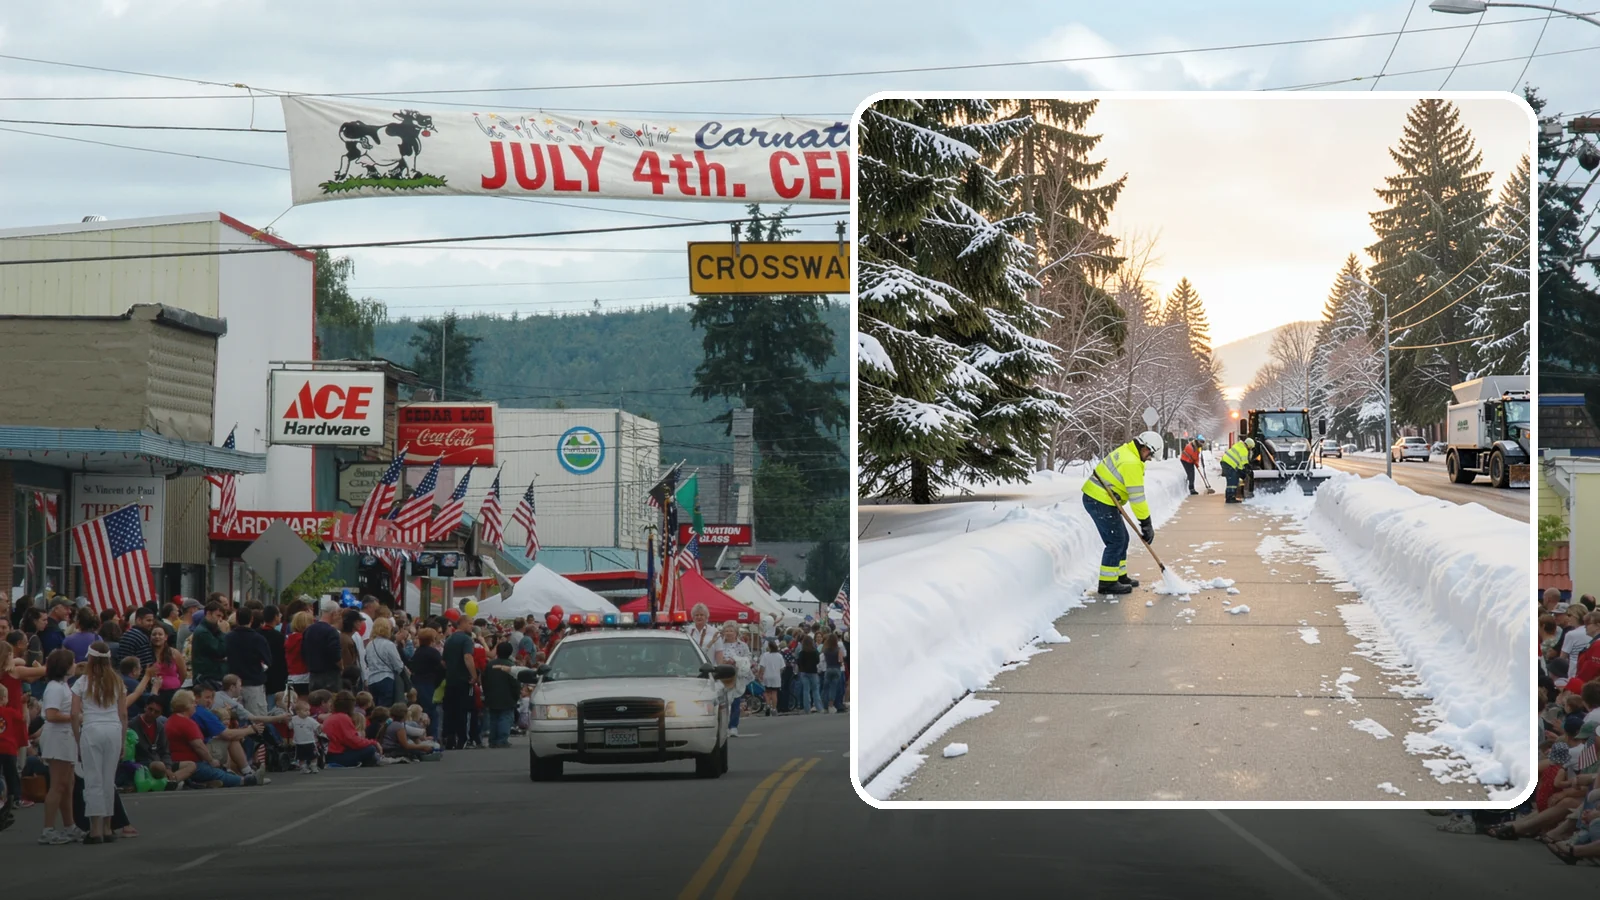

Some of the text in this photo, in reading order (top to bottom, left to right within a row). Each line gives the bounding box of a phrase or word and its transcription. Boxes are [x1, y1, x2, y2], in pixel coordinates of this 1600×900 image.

[481, 141, 605, 192] JULY
[632, 150, 746, 197] 4th.
[697, 254, 850, 280] CROSSWA
[283, 380, 373, 420] ACE
[406, 409, 452, 422] CEDAR
[283, 421, 371, 436] Hardware
[416, 428, 477, 447] Coca-Cola
[95, 486, 124, 495] Vincent
[126, 486, 136, 495] de
[138, 486, 155, 495] Paul
[699, 535, 730, 543] GLASS
